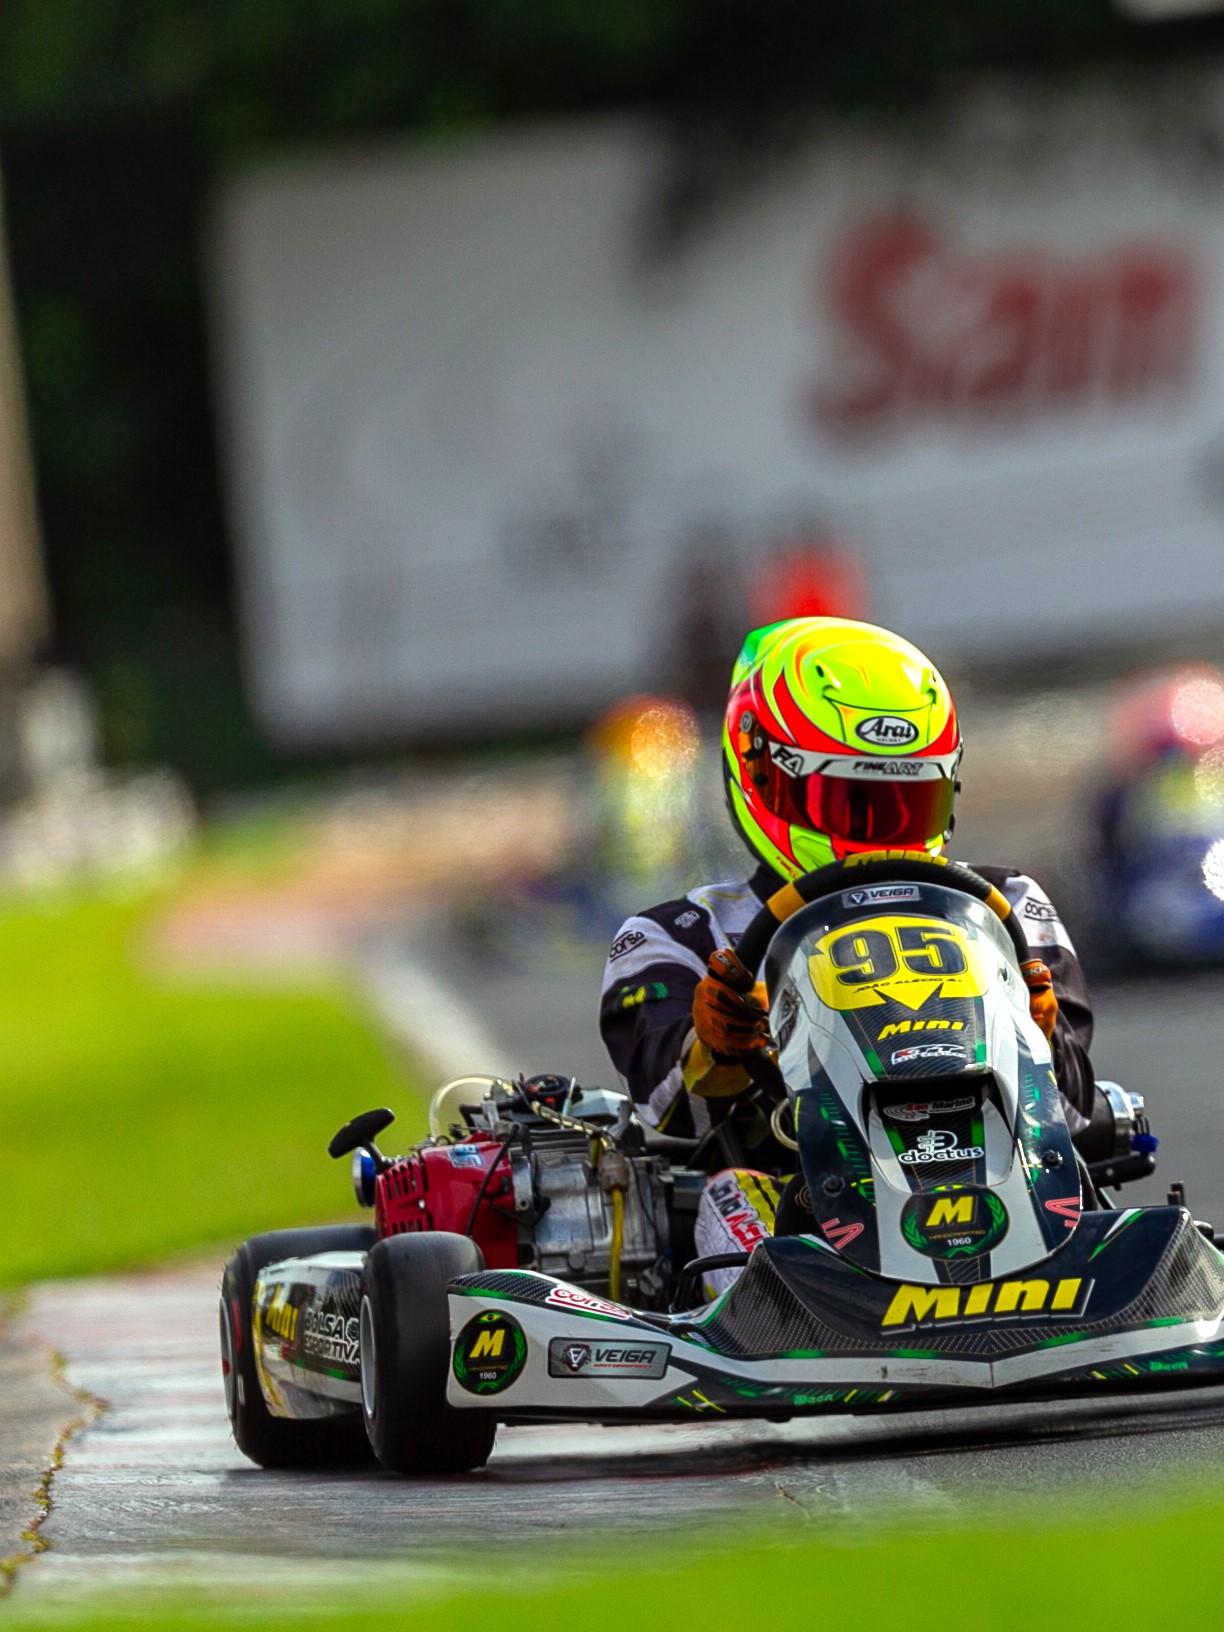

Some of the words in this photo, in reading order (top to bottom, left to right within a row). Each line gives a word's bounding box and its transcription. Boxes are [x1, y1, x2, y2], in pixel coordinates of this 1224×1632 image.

[808, 205, 1208, 440] San
[860, 717, 912, 738] Arai
[869, 887, 915, 898] VEIGA
[829, 926, 968, 986] 95
[905, 1103, 930, 1111] San
[899, 1149, 984, 1164] doctus
[925, 1196, 974, 1227] M
[947, 1237, 972, 1247] 1960
[469, 1329, 505, 1358] M
[595, 1349, 657, 1363] VEIGA
[479, 1372, 497, 1380] 1960
